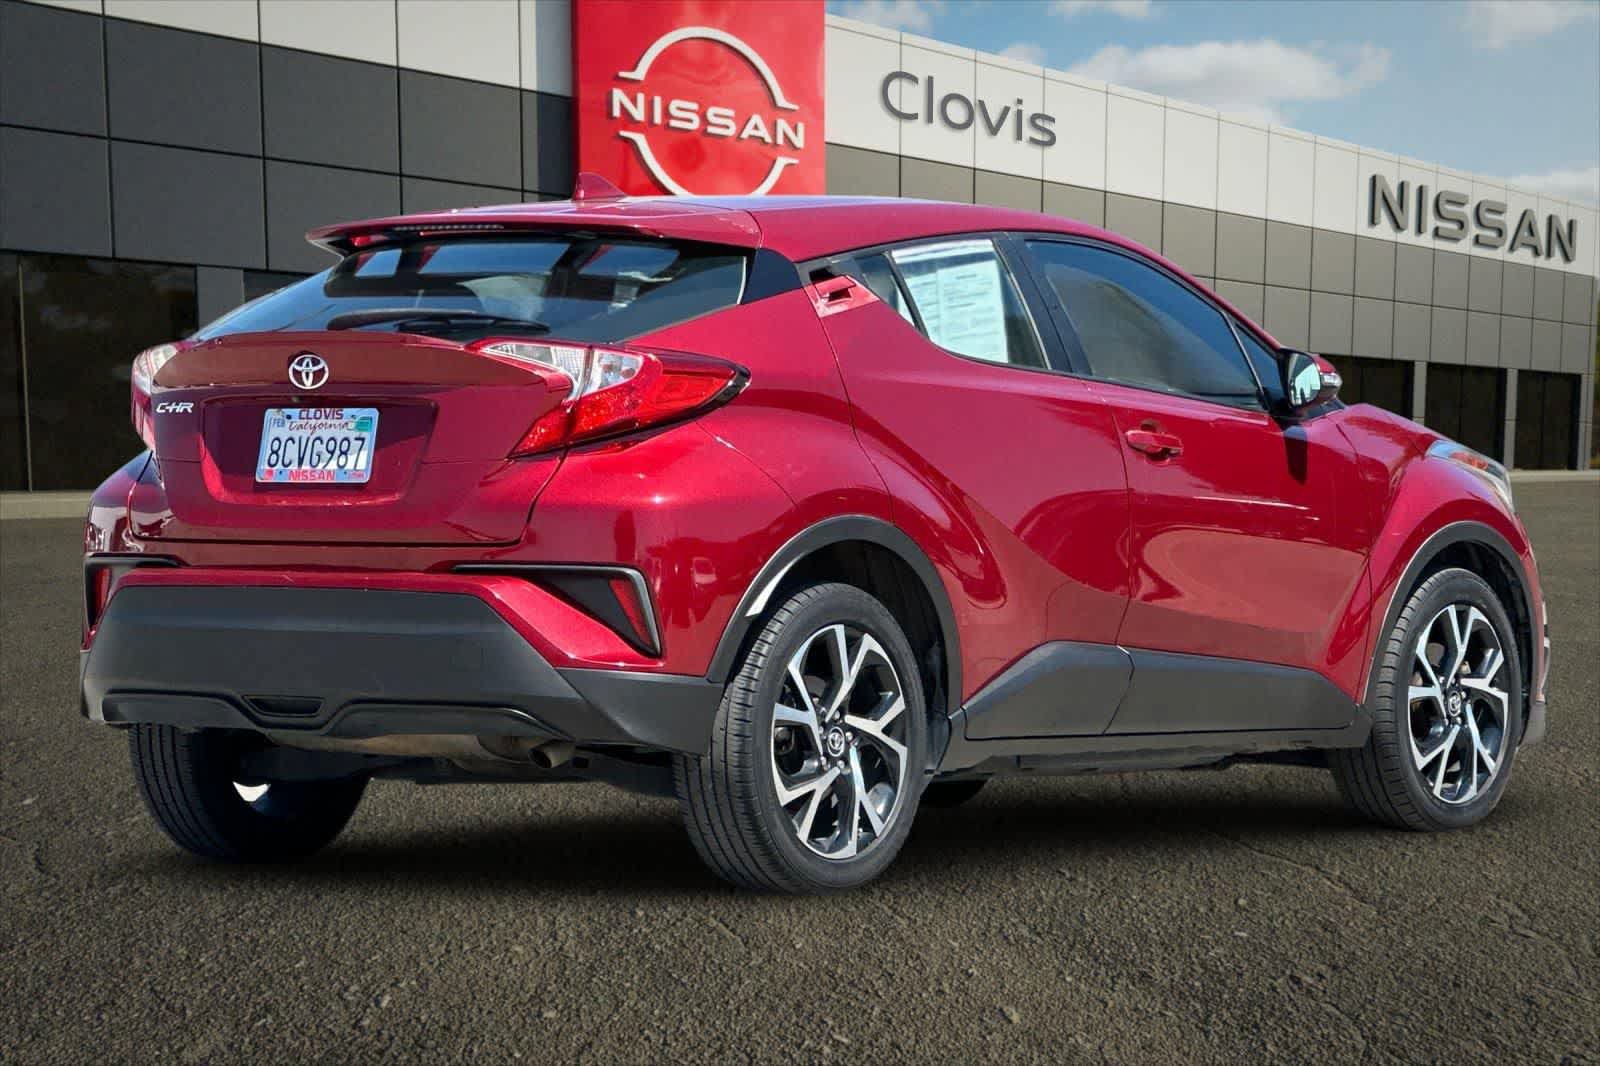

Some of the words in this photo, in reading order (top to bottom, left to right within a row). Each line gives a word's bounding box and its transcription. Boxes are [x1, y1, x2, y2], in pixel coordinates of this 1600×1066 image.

[610, 87, 805, 149] NISSAN
[881, 70, 1057, 147] Clovis
[1369, 174, 1577, 262] NISSAN
[156, 402, 194, 414] C-HR
[298, 408, 344, 420] CLOVIS
[288, 420, 349, 436] California
[267, 436, 366, 471] 8CVG987
[288, 469, 335, 481] NISSAN
